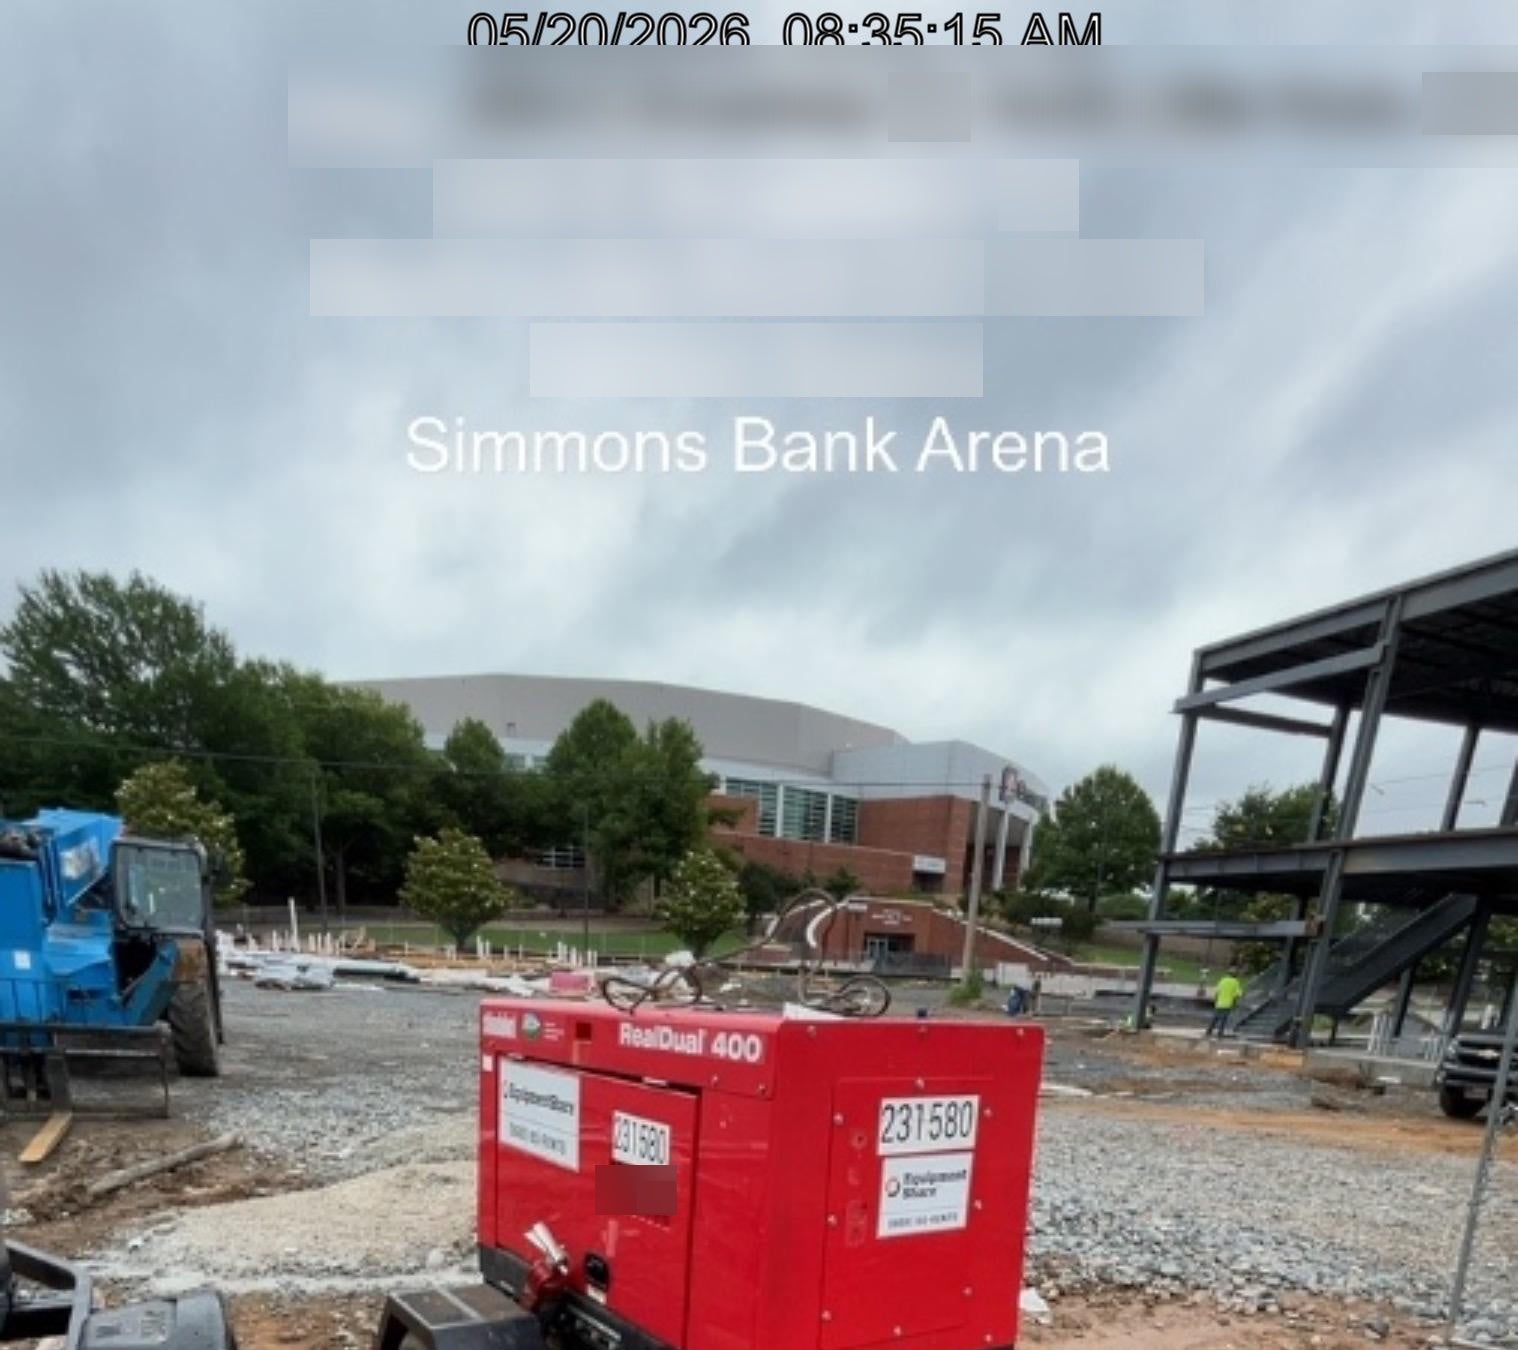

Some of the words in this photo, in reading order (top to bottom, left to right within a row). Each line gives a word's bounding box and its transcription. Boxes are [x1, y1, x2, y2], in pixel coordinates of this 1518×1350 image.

[619, 1022, 704, 1055] RealDual
[710, 1031, 763, 1064] 400
[614, 1115, 667, 1164] 231580
[881, 1100, 973, 1144] 231580
[903, 1168, 967, 1187] Equipment
